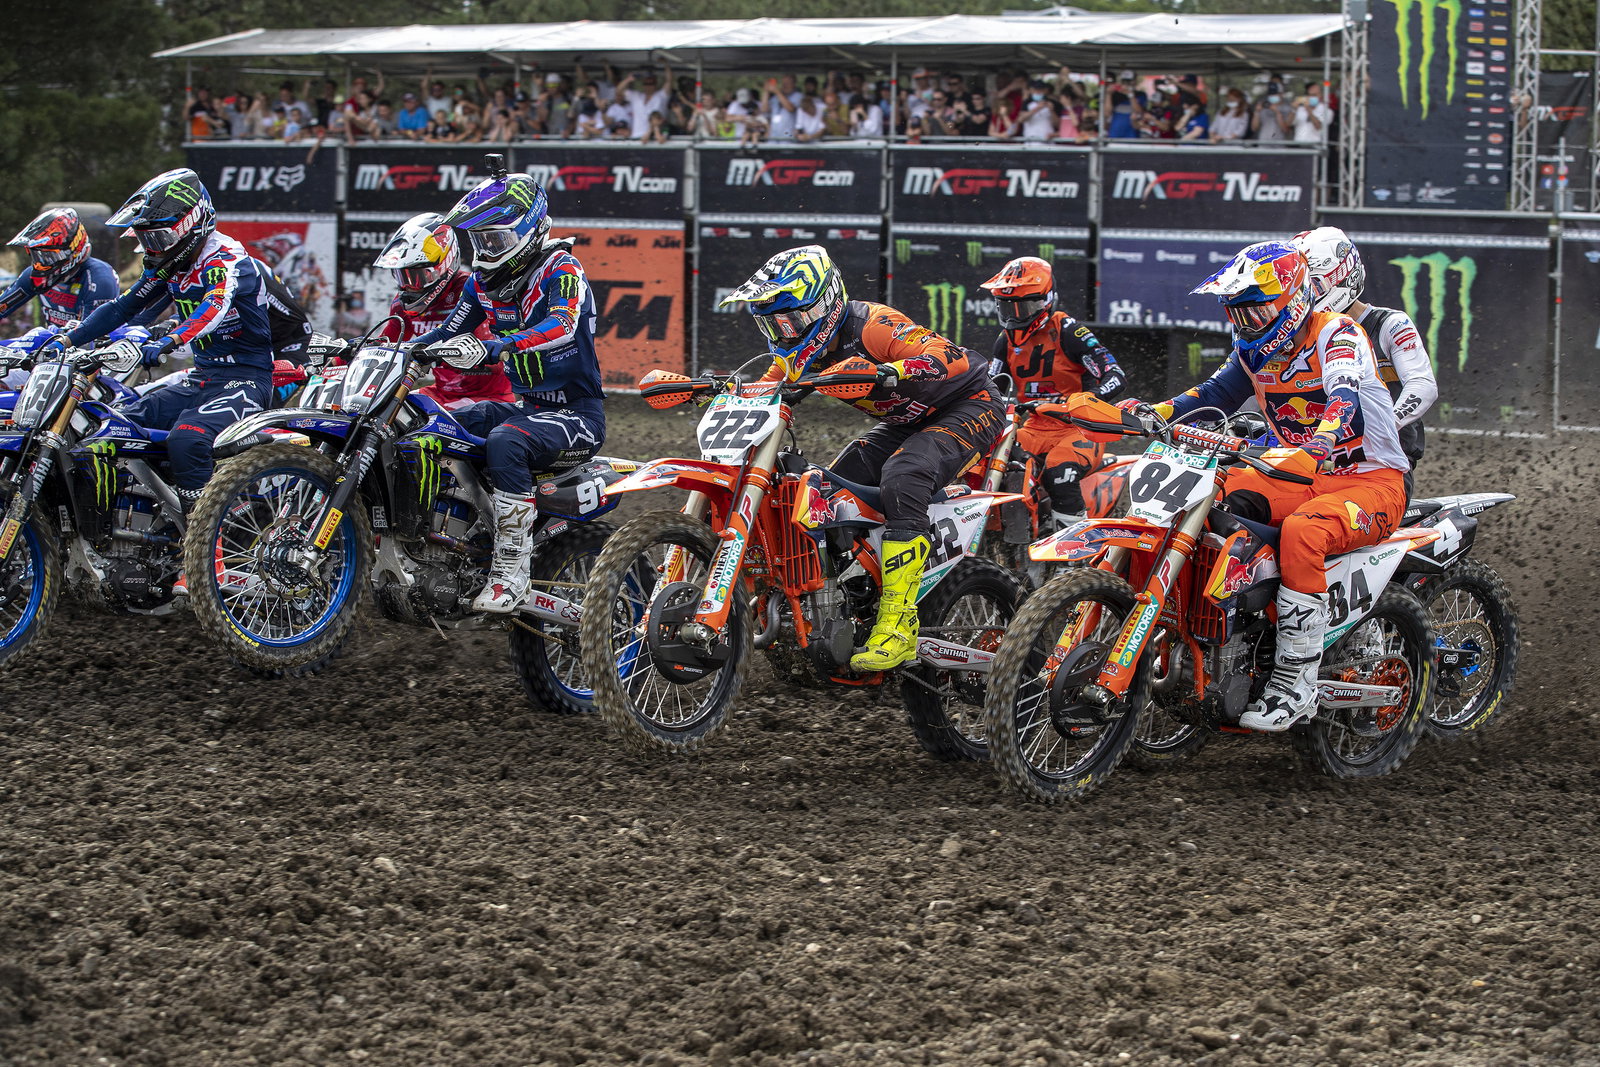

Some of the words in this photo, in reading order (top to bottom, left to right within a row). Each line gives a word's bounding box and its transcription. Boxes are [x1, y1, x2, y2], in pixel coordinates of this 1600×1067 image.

[218, 166, 275, 190] FOX
[1332, 292, 1347, 307] GROUPE
[446, 301, 472, 333] YAMAHA
[816, 319, 834, 343] Red
[831, 298, 843, 323] Bull
[1260, 326, 1287, 356] Red
[1282, 303, 1305, 332] Bull
[843, 361, 870, 371] KTM
[700, 409, 771, 450] 222
[121, 442, 148, 451] YZ
[449, 440, 474, 453] YZ
[613, 462, 636, 471] PIRELLI
[1130, 462, 1203, 513] 84
[318, 512, 340, 546] PIRELLI
[549, 524, 568, 537] WILVO
[966, 511, 983, 521] ATHENA
[1433, 517, 1463, 557] 4
[712, 545, 731, 582] ATHENA
[721, 534, 745, 588] MOTOREX
[885, 546, 916, 575] SIDI
[534, 596, 556, 610] RK
[1327, 569, 1373, 628] 84
[1113, 610, 1141, 654] PIRELLI
[1129, 602, 1159, 652] MOTOREX
